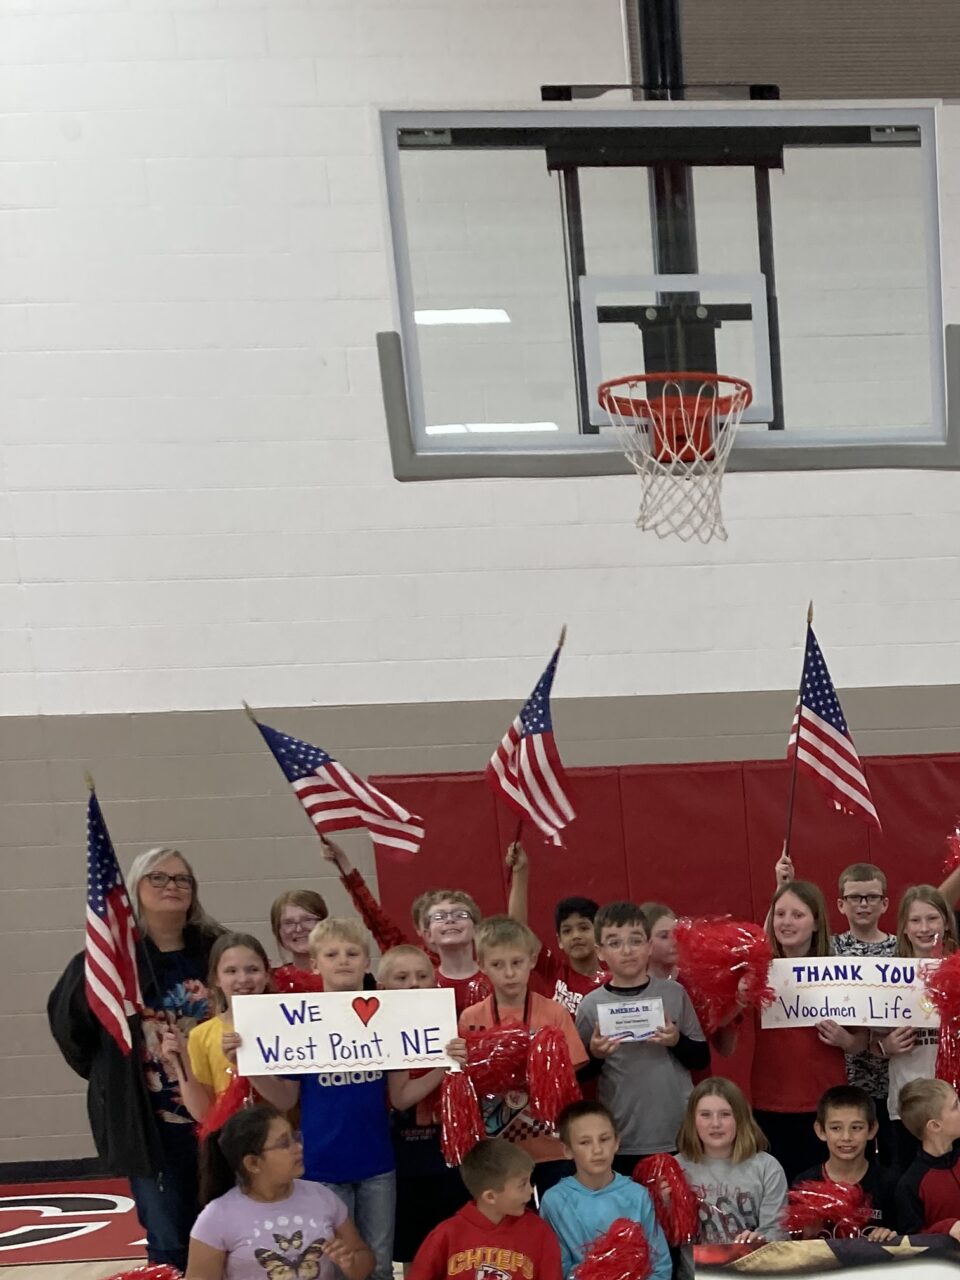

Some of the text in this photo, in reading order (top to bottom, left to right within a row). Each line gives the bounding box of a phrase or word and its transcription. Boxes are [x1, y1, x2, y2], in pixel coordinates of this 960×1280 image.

[793, 964, 915, 983] THANK YOU
[279, 1000, 322, 1026] WE
[779, 994, 912, 1019] Woodmen Life
[256, 1035, 317, 1064] West
[401, 1027, 443, 1056] NE
[318, 1070, 383, 1087] adidas
